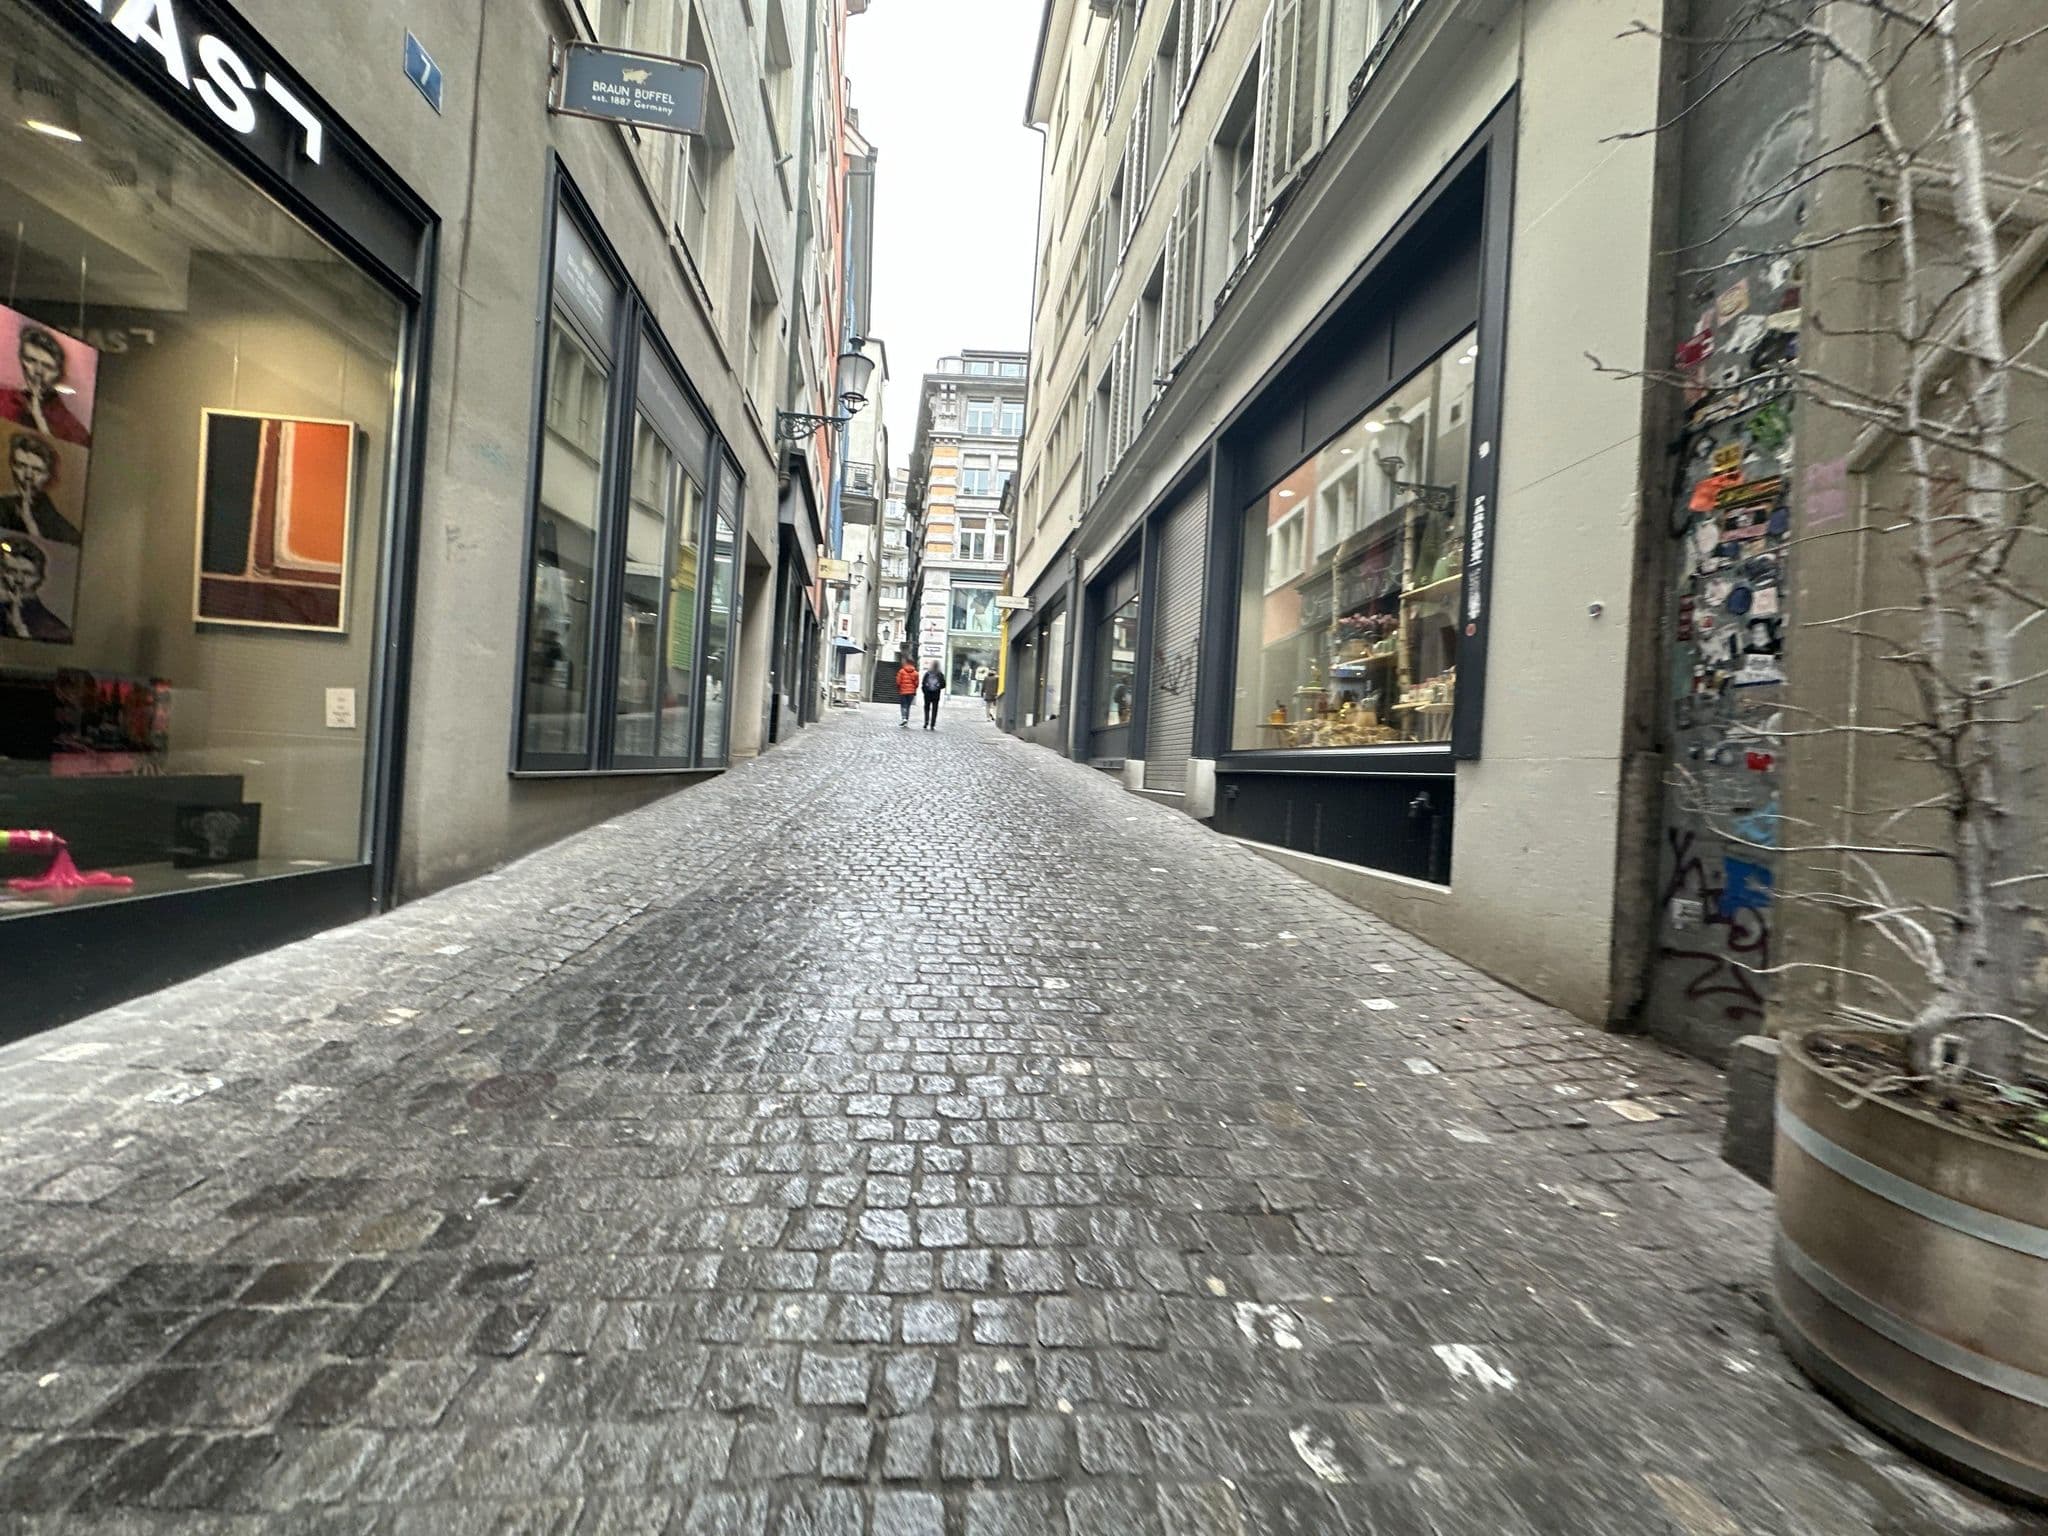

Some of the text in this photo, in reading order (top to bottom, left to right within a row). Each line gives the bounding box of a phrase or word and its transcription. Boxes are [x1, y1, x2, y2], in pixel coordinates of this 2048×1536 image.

[420, 54, 431, 86] 7
[592, 81, 630, 96] BRAUN
[611, 97, 630, 106] 1887
[633, 101, 673, 116] Germany
